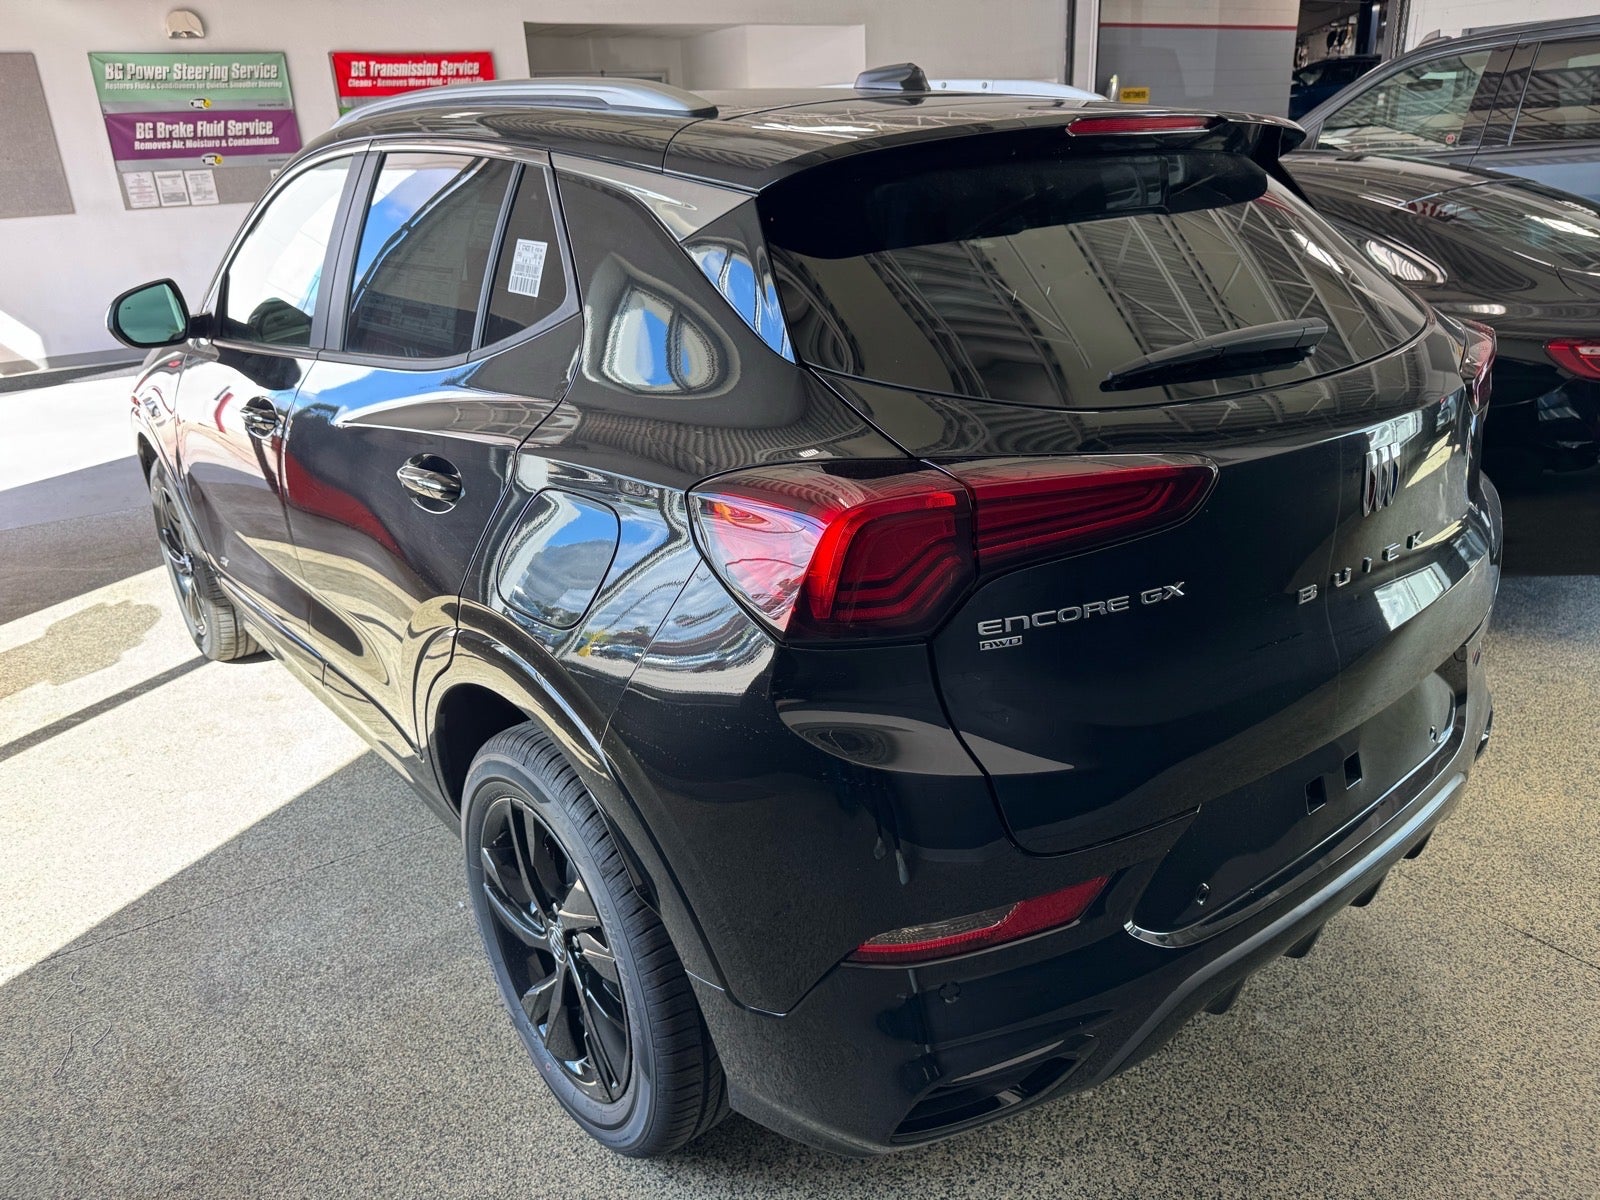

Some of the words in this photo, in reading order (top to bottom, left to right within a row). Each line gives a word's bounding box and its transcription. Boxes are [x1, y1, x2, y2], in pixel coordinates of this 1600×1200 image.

[105, 62, 124, 80] BG
[126, 62, 170, 80] Power
[173, 62, 229, 82] Steering
[231, 62, 278, 79] Service
[351, 61, 366, 77] BG
[369, 60, 438, 77] Transmission
[440, 60, 480, 76] Service
[135, 122, 154, 140] BG
[156, 121, 195, 139] Brake
[196, 120, 225, 138] Fluid
[227, 119, 274, 136] Service
[134, 141, 171, 151] Removes
[185, 138, 220, 149] Moisture
[228, 136, 280, 147] Contaminants
[1298, 531, 1424, 605] BUICK
[977, 595, 1130, 636] ENCORE
[1140, 581, 1185, 605] GX
[980, 635, 1023, 651] AWD
